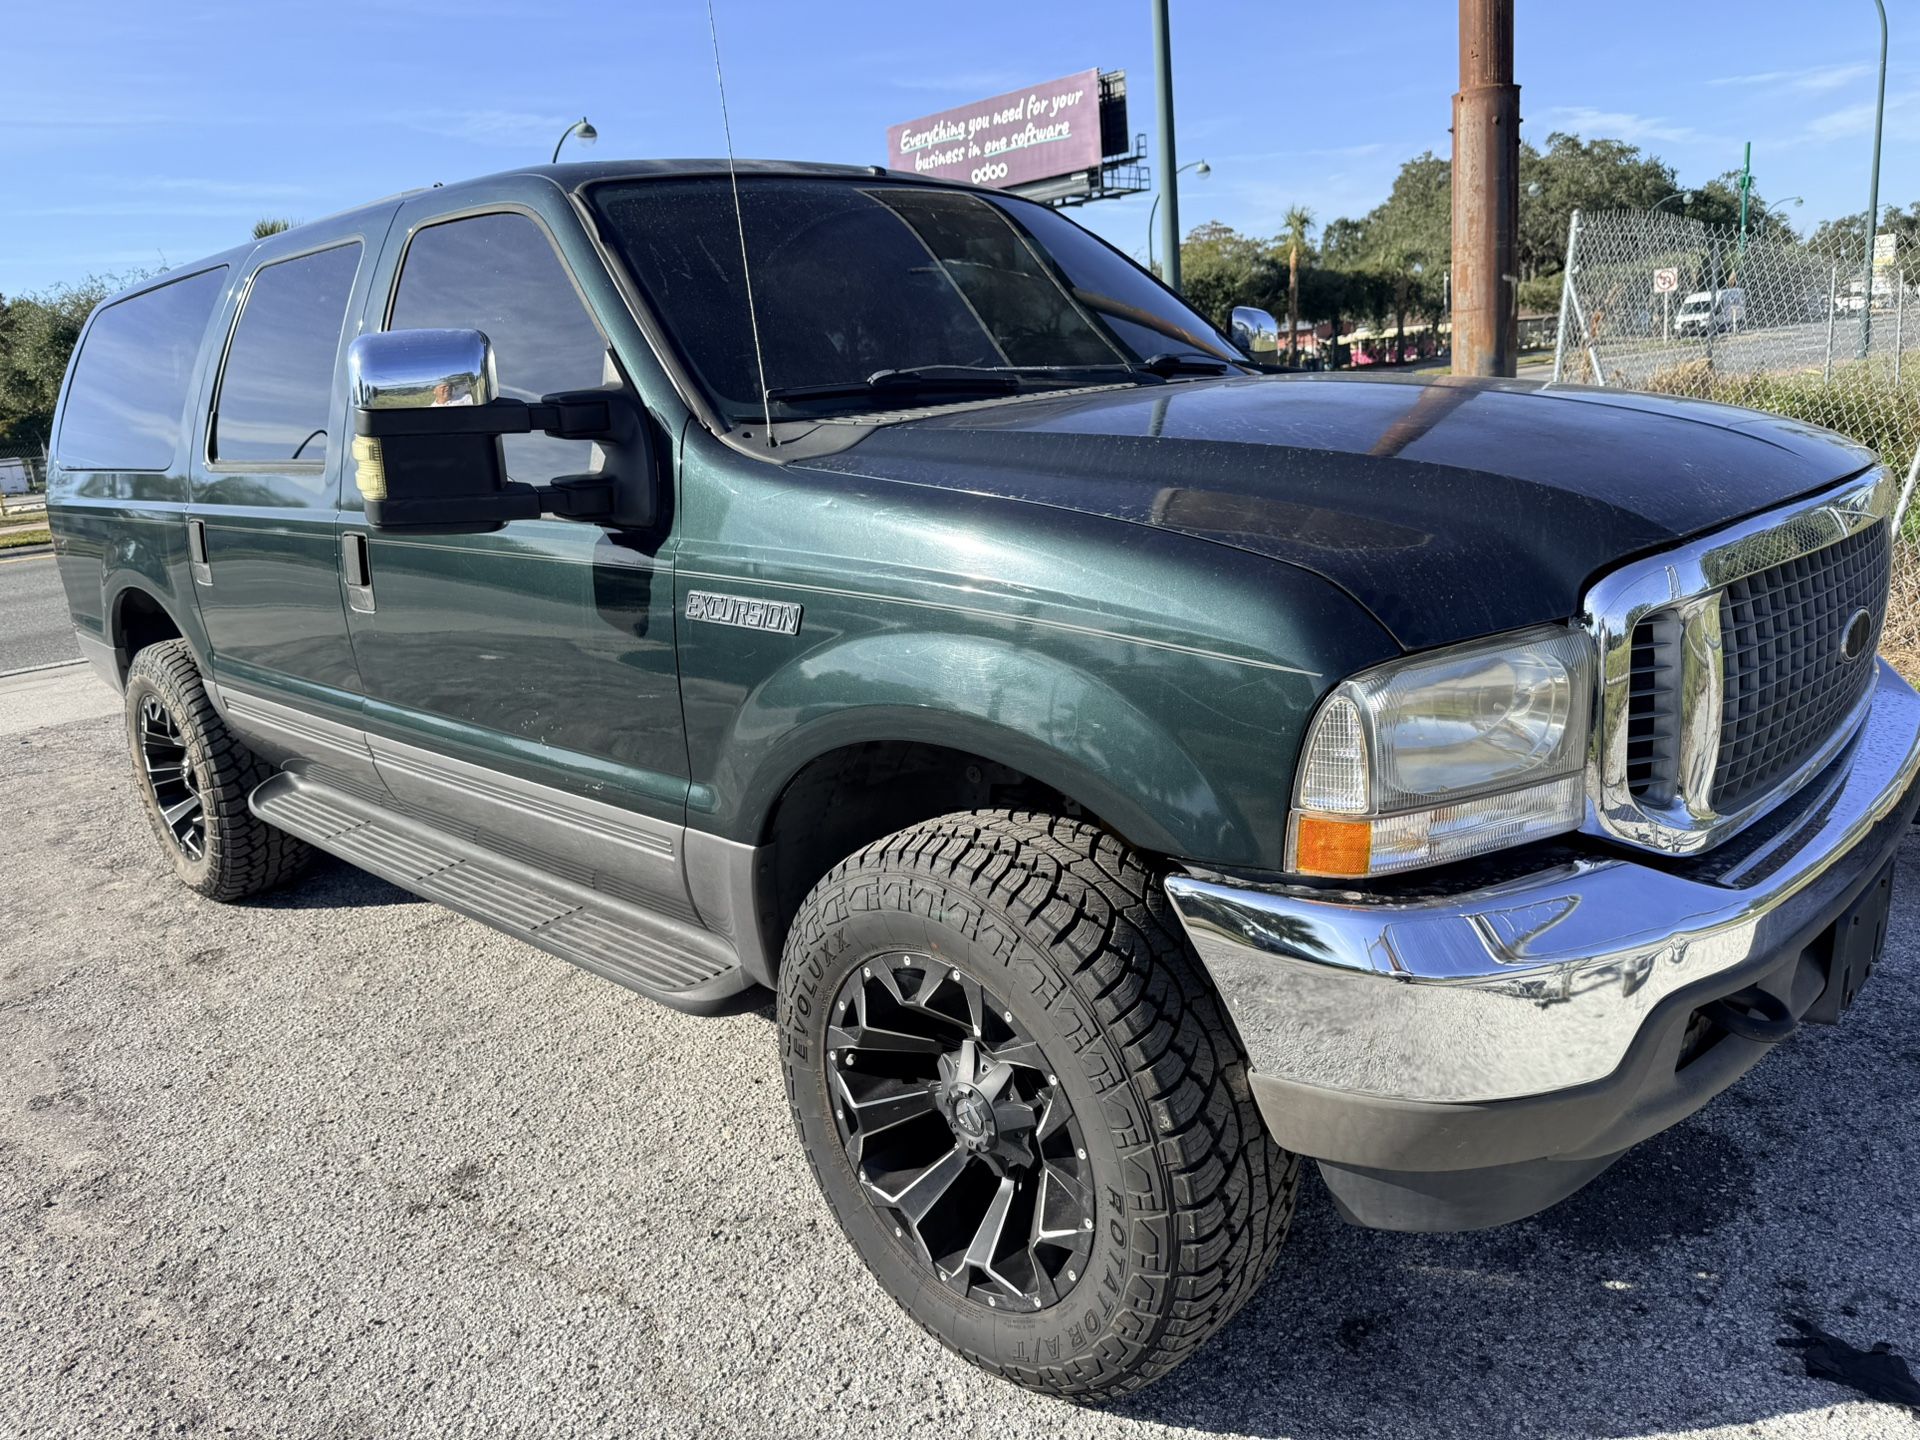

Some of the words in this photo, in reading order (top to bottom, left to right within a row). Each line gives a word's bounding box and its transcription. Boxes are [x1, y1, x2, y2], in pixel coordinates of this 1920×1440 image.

[901, 120, 966, 150] Everything
[968, 114, 990, 139] you
[993, 98, 1025, 125] need
[1026, 94, 1049, 119] for
[1050, 89, 1083, 116] your
[915, 145, 964, 171] business
[968, 142, 981, 158] in
[984, 137, 1007, 154] one
[1010, 121, 1071, 148] software
[971, 162, 1008, 184] odoo
[686, 593, 800, 633] EXCURSION
[794, 926, 850, 1063] EVOLUXX
[1065, 1184, 1127, 1351] ROTATOR
[1012, 1335, 1061, 1363] A/T
